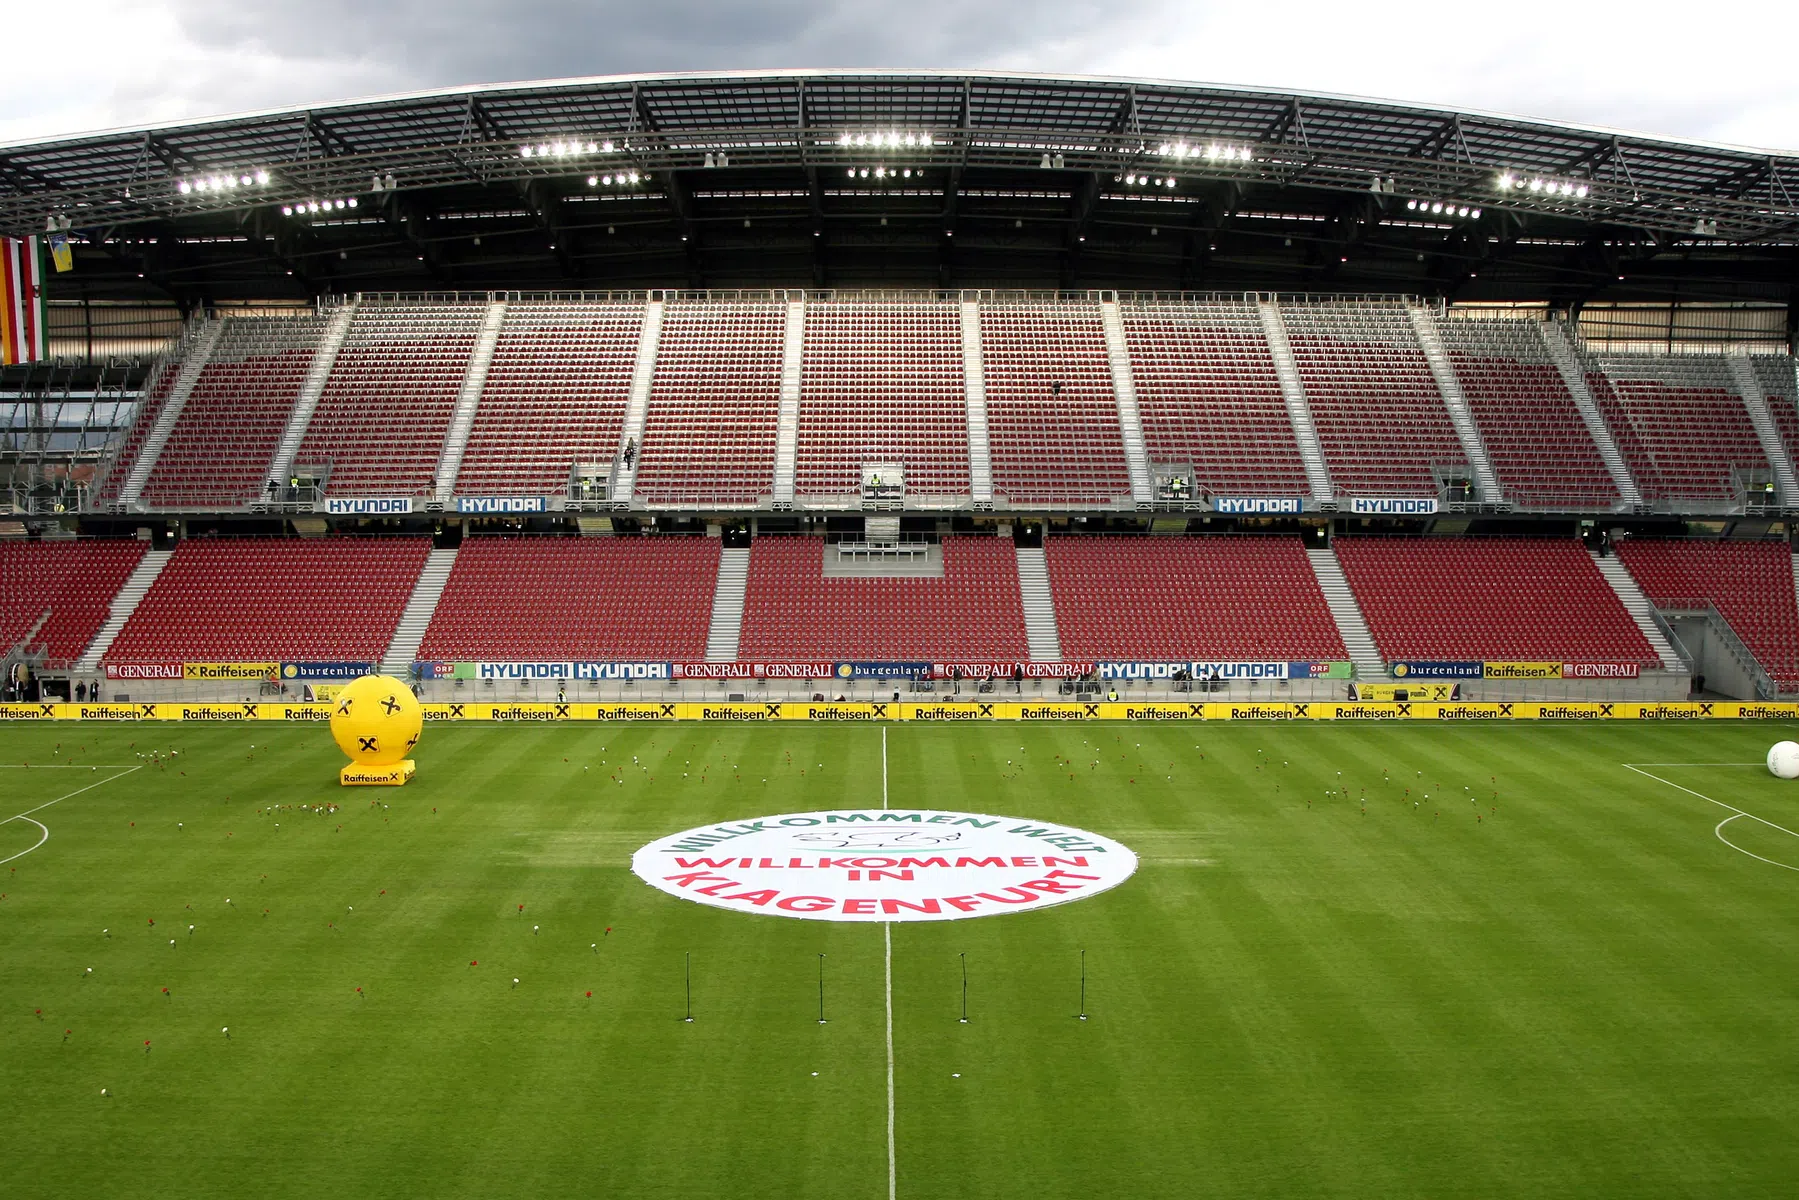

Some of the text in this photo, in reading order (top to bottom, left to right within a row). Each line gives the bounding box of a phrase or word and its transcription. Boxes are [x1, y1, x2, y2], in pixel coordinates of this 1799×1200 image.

[329, 499, 408, 512] HYUNDAI
[461, 498, 541, 511] HYUNDAI
[1218, 499, 1297, 512] HYUNDAI
[1355, 500, 1433, 512] HYUNDAI
[118, 664, 182, 678] GENERALI
[200, 663, 266, 677] Raiffeisen
[301, 665, 371, 676] burgenland
[481, 664, 569, 677] HYUNDAI
[579, 663, 666, 678] HYUNDAI
[684, 664, 751, 677] GENERALI
[765, 664, 832, 677] GENERALI
[855, 665, 928, 675] burgenland
[1196, 663, 1283, 677] HYUNDAI
[1410, 665, 1480, 675] burgenland
[1486, 664, 1546, 677] Raiffeisen
[1574, 664, 1638, 677] GENERALI
[0, 707, 39, 719] ffeisen
[81, 707, 141, 719] Raiffeisen
[183, 707, 242, 719] Raiffeisen
[285, 707, 332, 719] Raiffeis
[492, 707, 553, 719] Raiffeisen
[597, 707, 659, 719] Raiffeisen
[703, 707, 765, 719] Raiffeisen
[809, 707, 870, 719] Raiffeisen
[915, 707, 977, 719] Raiffeisen
[1021, 707, 1083, 719] Raiffeisen
[1126, 707, 1188, 719] Raiffeisen
[1231, 707, 1292, 719] Raiffeisen
[1336, 707, 1395, 719] Raiffeisen
[1438, 707, 1497, 719] Raiffeisen
[1539, 706, 1598, 718] Raiffeisen
[1640, 706, 1697, 718] Raiffeisen
[1739, 706, 1795, 718] Raiffeisen
[344, 773, 388, 783] Raiffeisen
[660, 813, 1107, 852] WILLKOMMEN WELT
[674, 856, 1089, 868] WILLKOMMEN
[848, 869, 914, 881] IN
[663, 870, 1101, 914] KLAGENFURT
